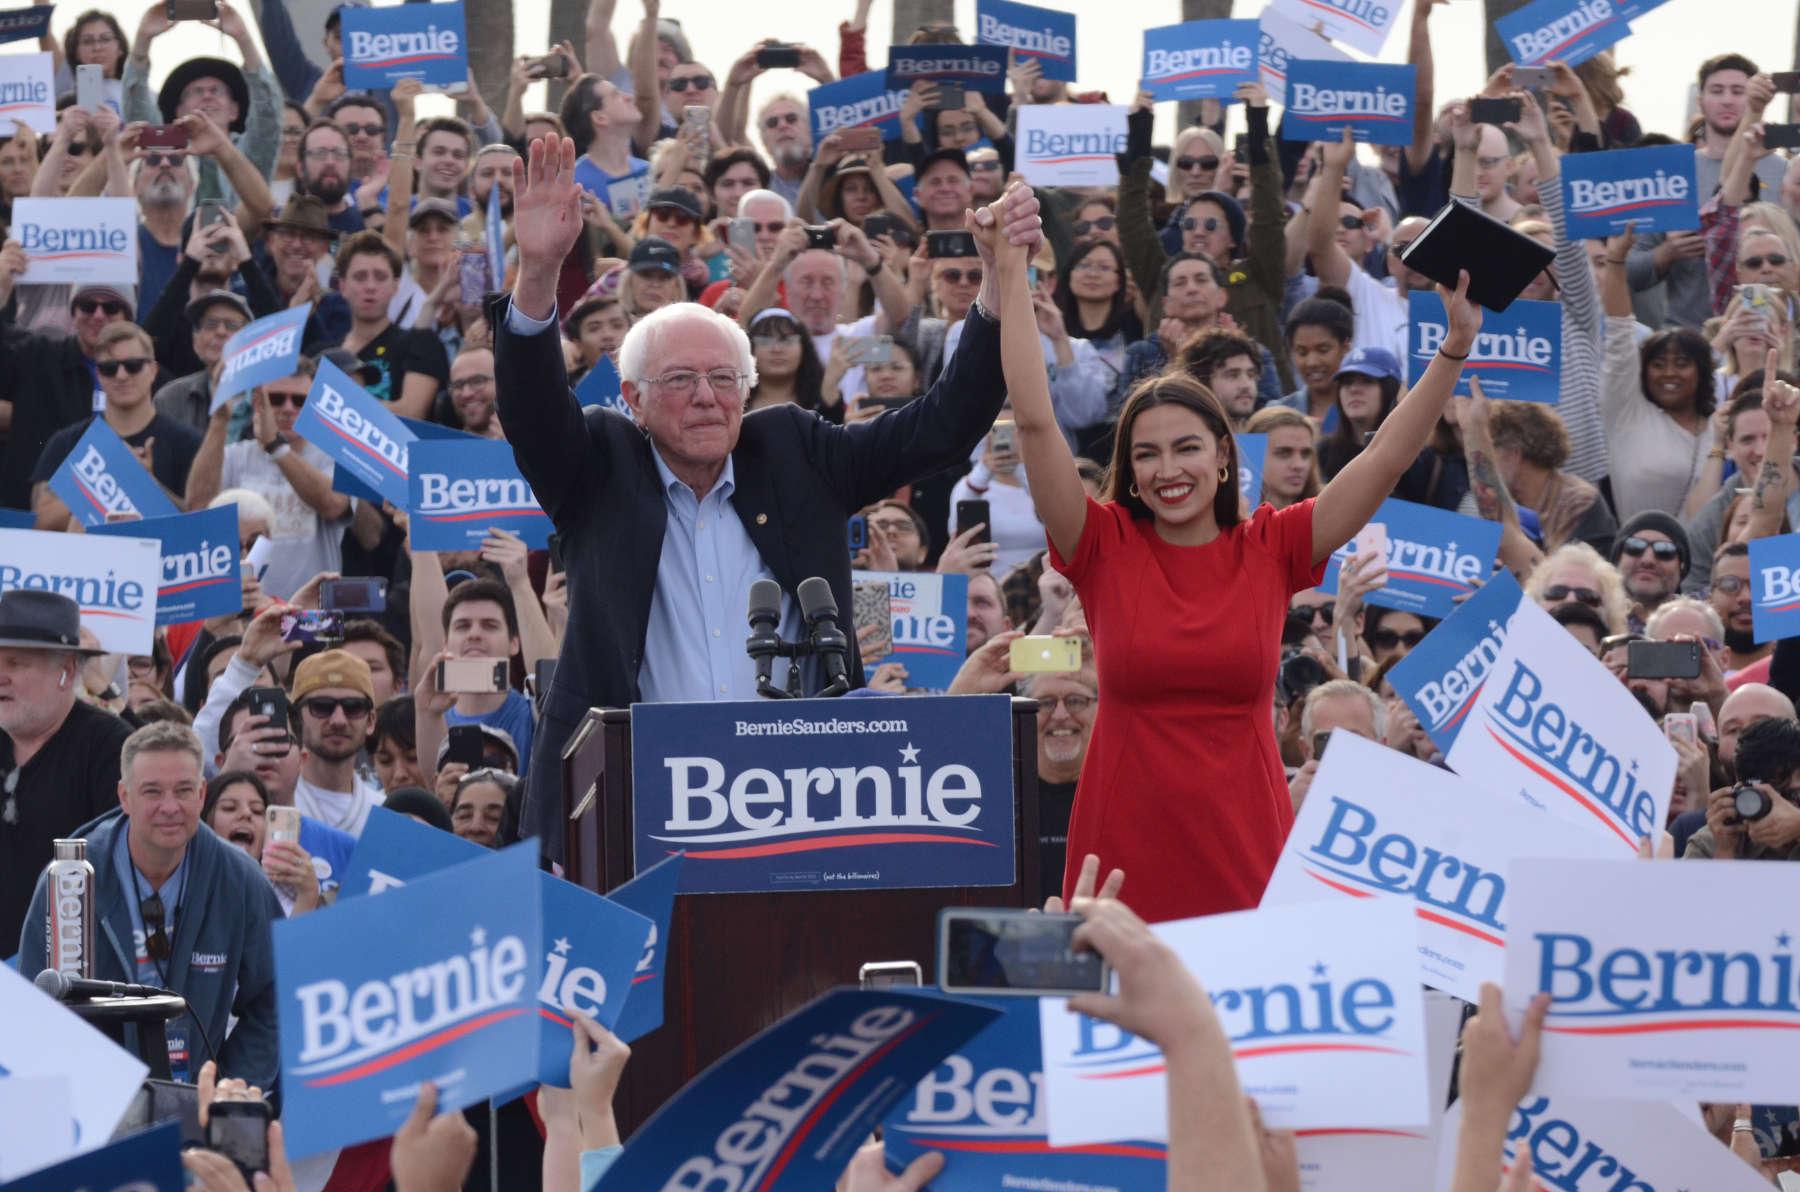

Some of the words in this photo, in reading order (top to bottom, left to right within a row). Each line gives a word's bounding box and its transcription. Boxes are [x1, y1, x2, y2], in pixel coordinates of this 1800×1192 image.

[349, 25, 458, 58] Bernie
[981, 14, 1070, 55] Bernie
[1511, 0, 1613, 60] Bernie
[894, 57, 999, 74] Bernie
[1147, 40, 1252, 75] Bernie
[0, 76, 48, 102] rnie
[1292, 83, 1407, 116] Bernie
[1027, 127, 1128, 155] Bernie
[1569, 169, 1688, 208] Bernie
[21, 222, 127, 252] Bernie
[1418, 322, 1552, 364] Brnie
[419, 473, 538, 509] Bern
[159, 540, 232, 583] rnie
[735, 718, 908, 736] BernieSanders.com
[1493, 658, 1656, 838] Bernie
[664, 741, 983, 831] Bernie
[1310, 795, 1506, 931] Bern
[1534, 930, 1800, 1012] Berni
[296, 925, 527, 1062] Bernie
[1072, 962, 1395, 1056] Brnie
